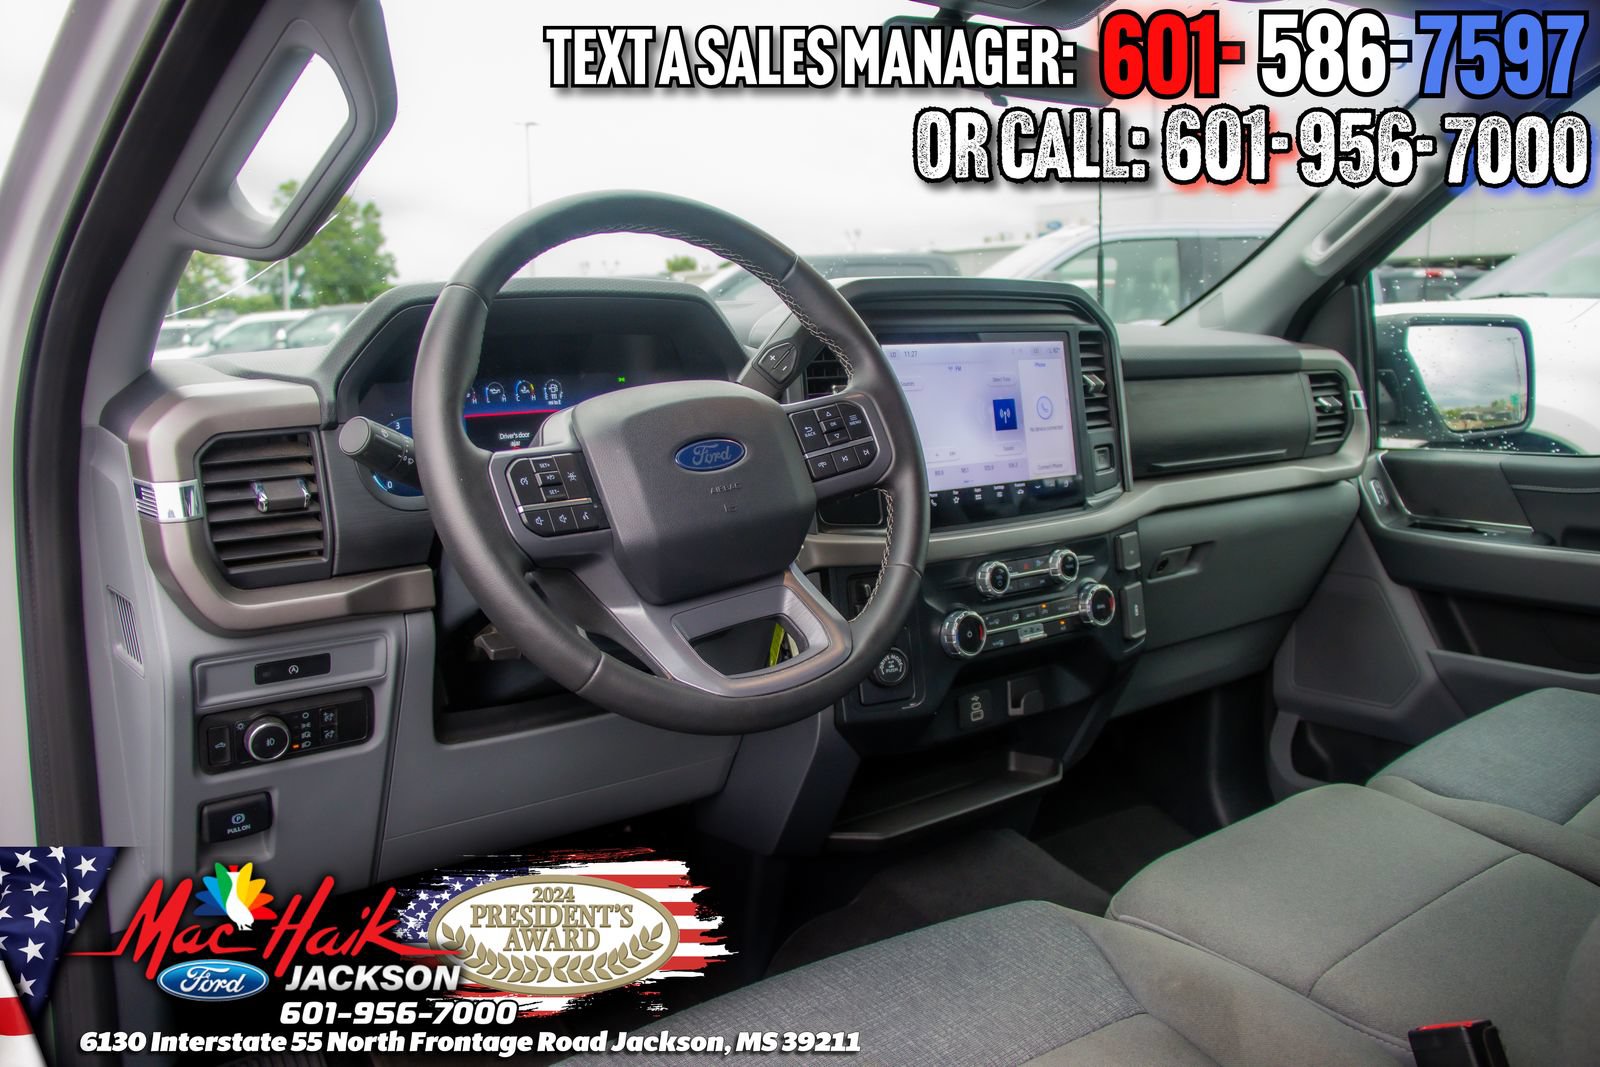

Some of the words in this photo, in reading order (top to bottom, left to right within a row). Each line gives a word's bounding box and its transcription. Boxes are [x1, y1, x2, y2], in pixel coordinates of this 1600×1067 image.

[499, 432, 518, 440] Driver's
[692, 443, 732, 466] Ford
[387, 481, 393, 489] 0
[227, 827, 241, 835] PULL
